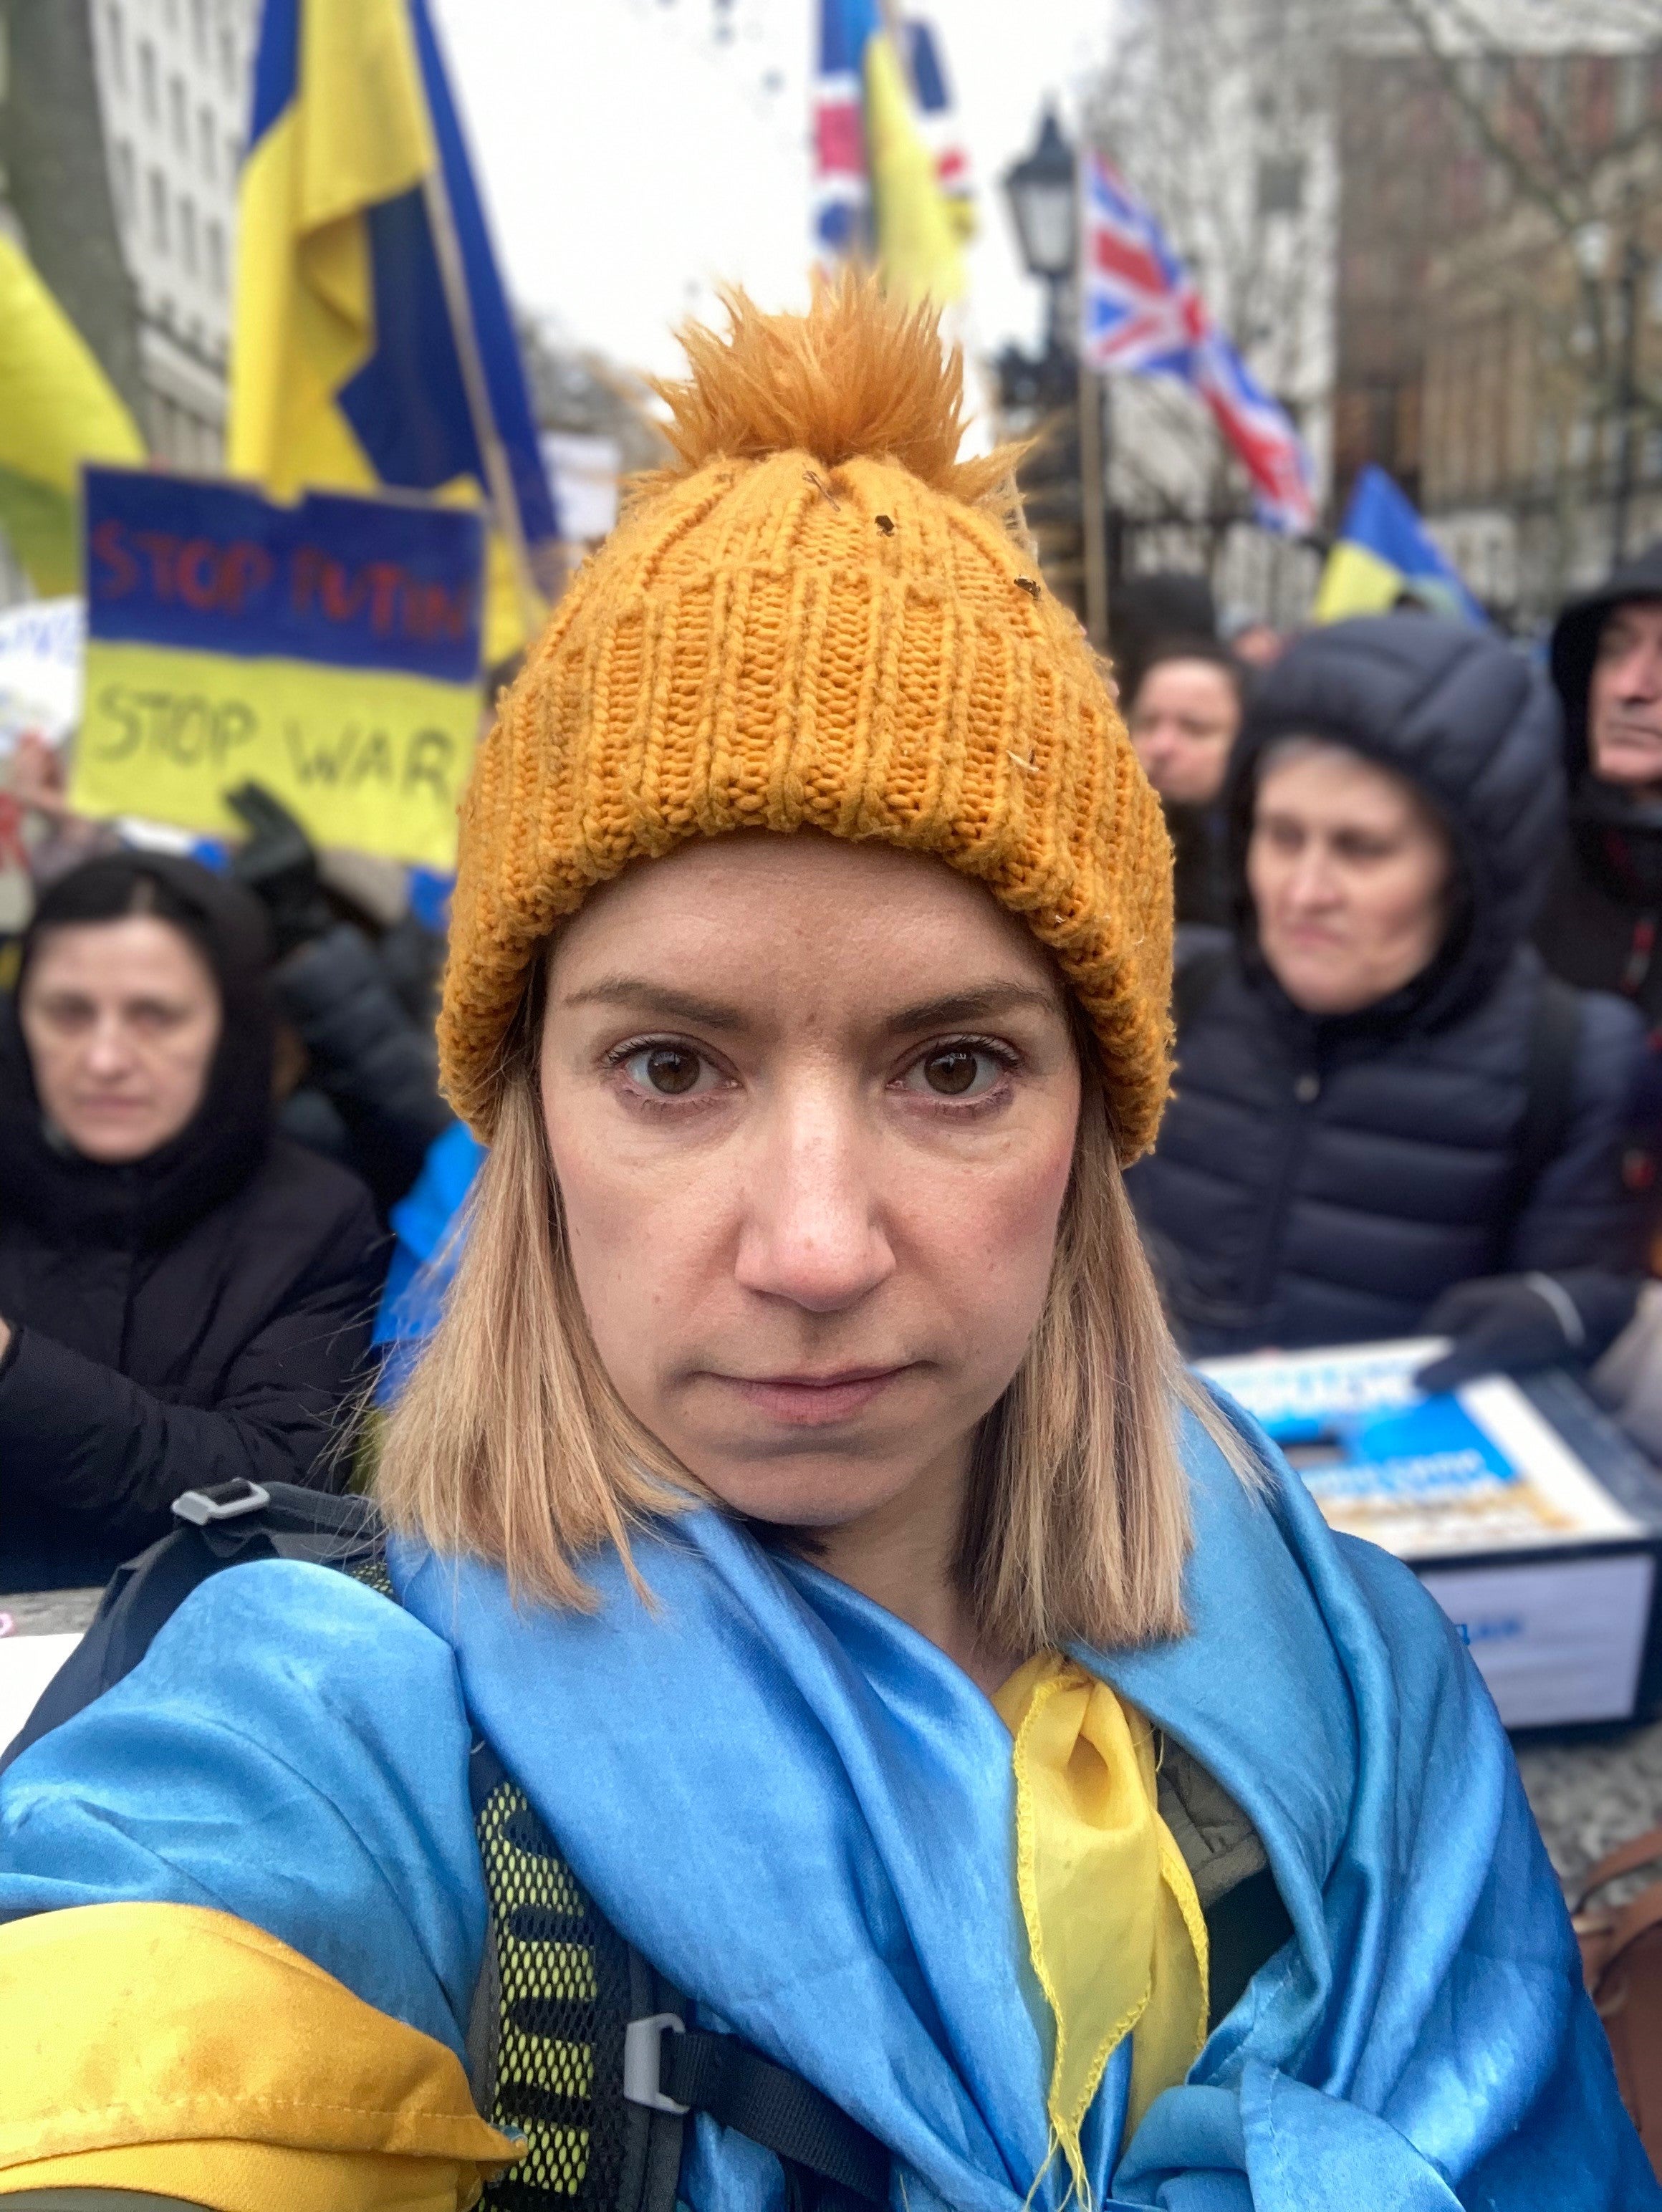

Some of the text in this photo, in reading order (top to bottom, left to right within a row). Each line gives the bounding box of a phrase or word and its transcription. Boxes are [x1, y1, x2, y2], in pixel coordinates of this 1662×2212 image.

[92, 519, 470, 640] STOP PUTIN
[96, 686, 454, 800] STOP WAR
